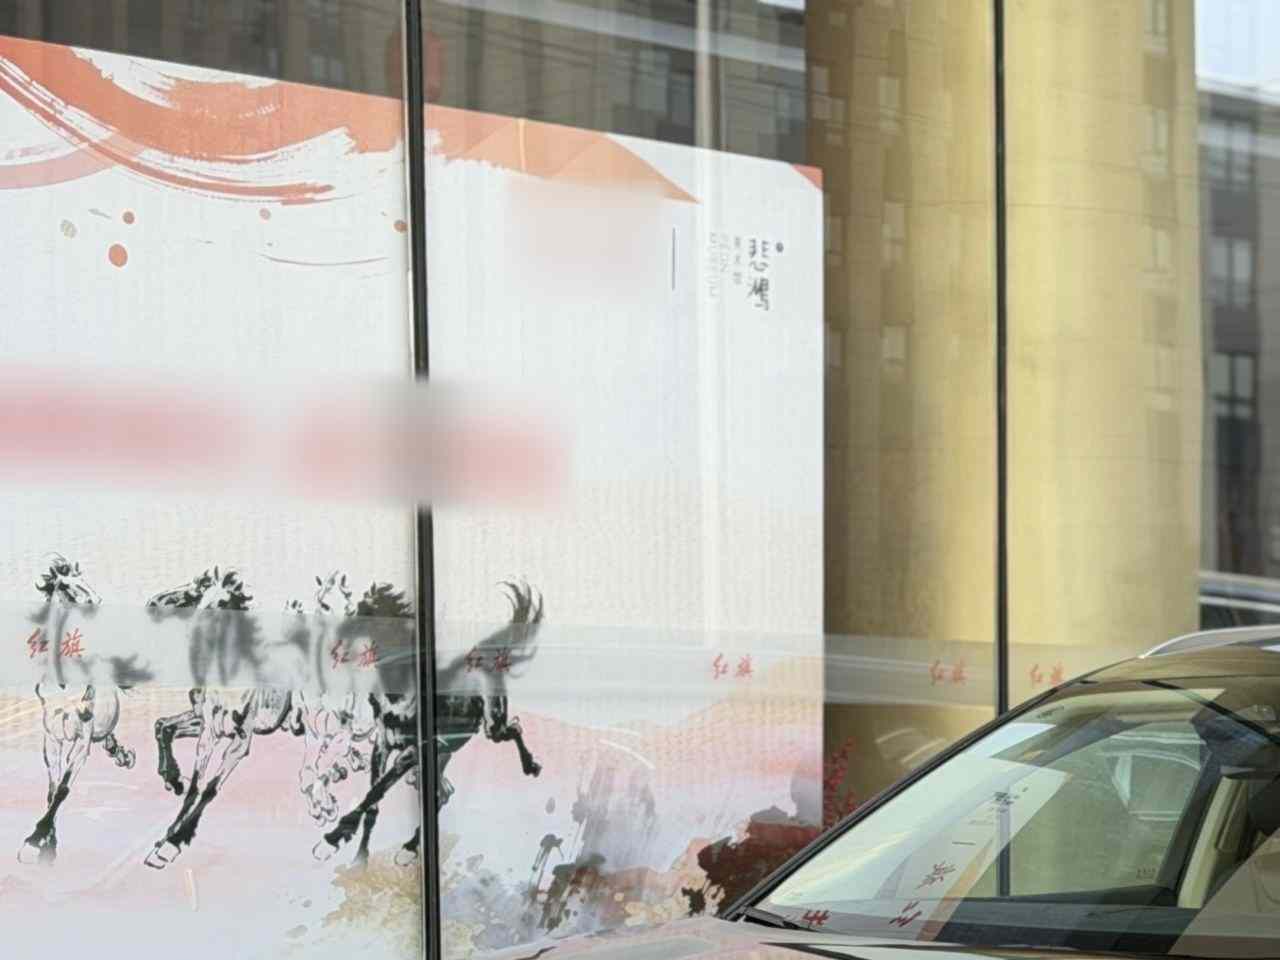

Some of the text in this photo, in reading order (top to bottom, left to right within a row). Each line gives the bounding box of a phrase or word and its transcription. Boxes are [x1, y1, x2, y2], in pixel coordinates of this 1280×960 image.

[27, 627, 85, 659] 红旗
[331, 639, 381, 670] 红旗
[713, 652, 754, 680] 红旗
